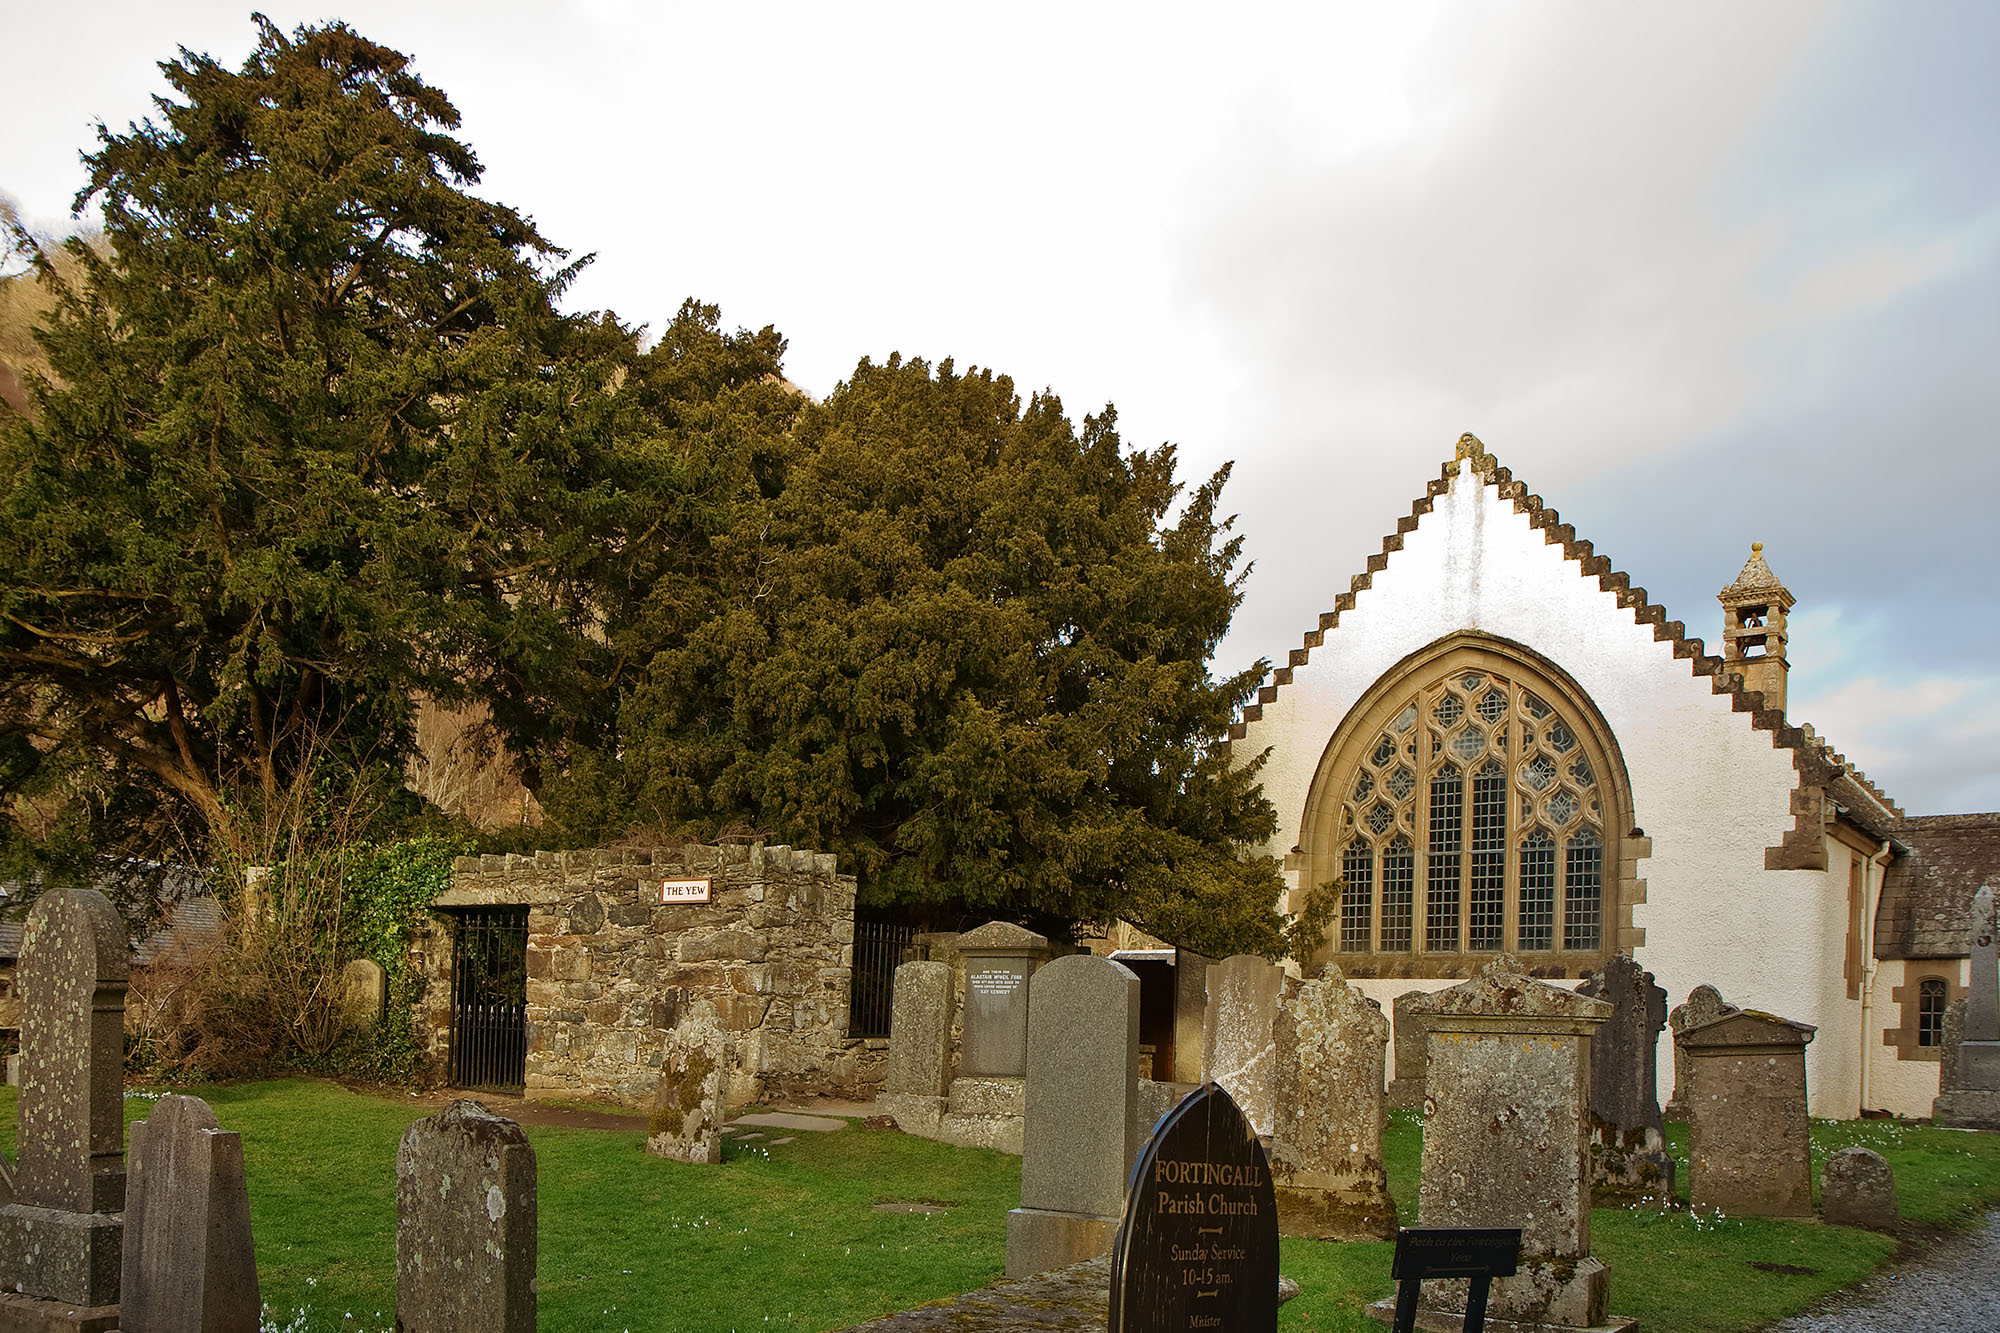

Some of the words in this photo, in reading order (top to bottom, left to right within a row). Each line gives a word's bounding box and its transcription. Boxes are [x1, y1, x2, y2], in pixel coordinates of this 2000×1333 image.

[666, 886, 684, 896] THE
[686, 886, 705, 895] YEW
[1155, 1160, 1263, 1187] FORTINGALL
[1158, 1191, 1205, 1214] Parish
[1208, 1193, 1258, 1216] Church
[1171, 1243, 1209, 1264] Sunday
[1210, 1243, 1246, 1260] Service
[1183, 1267, 1213, 1286] 10-15
